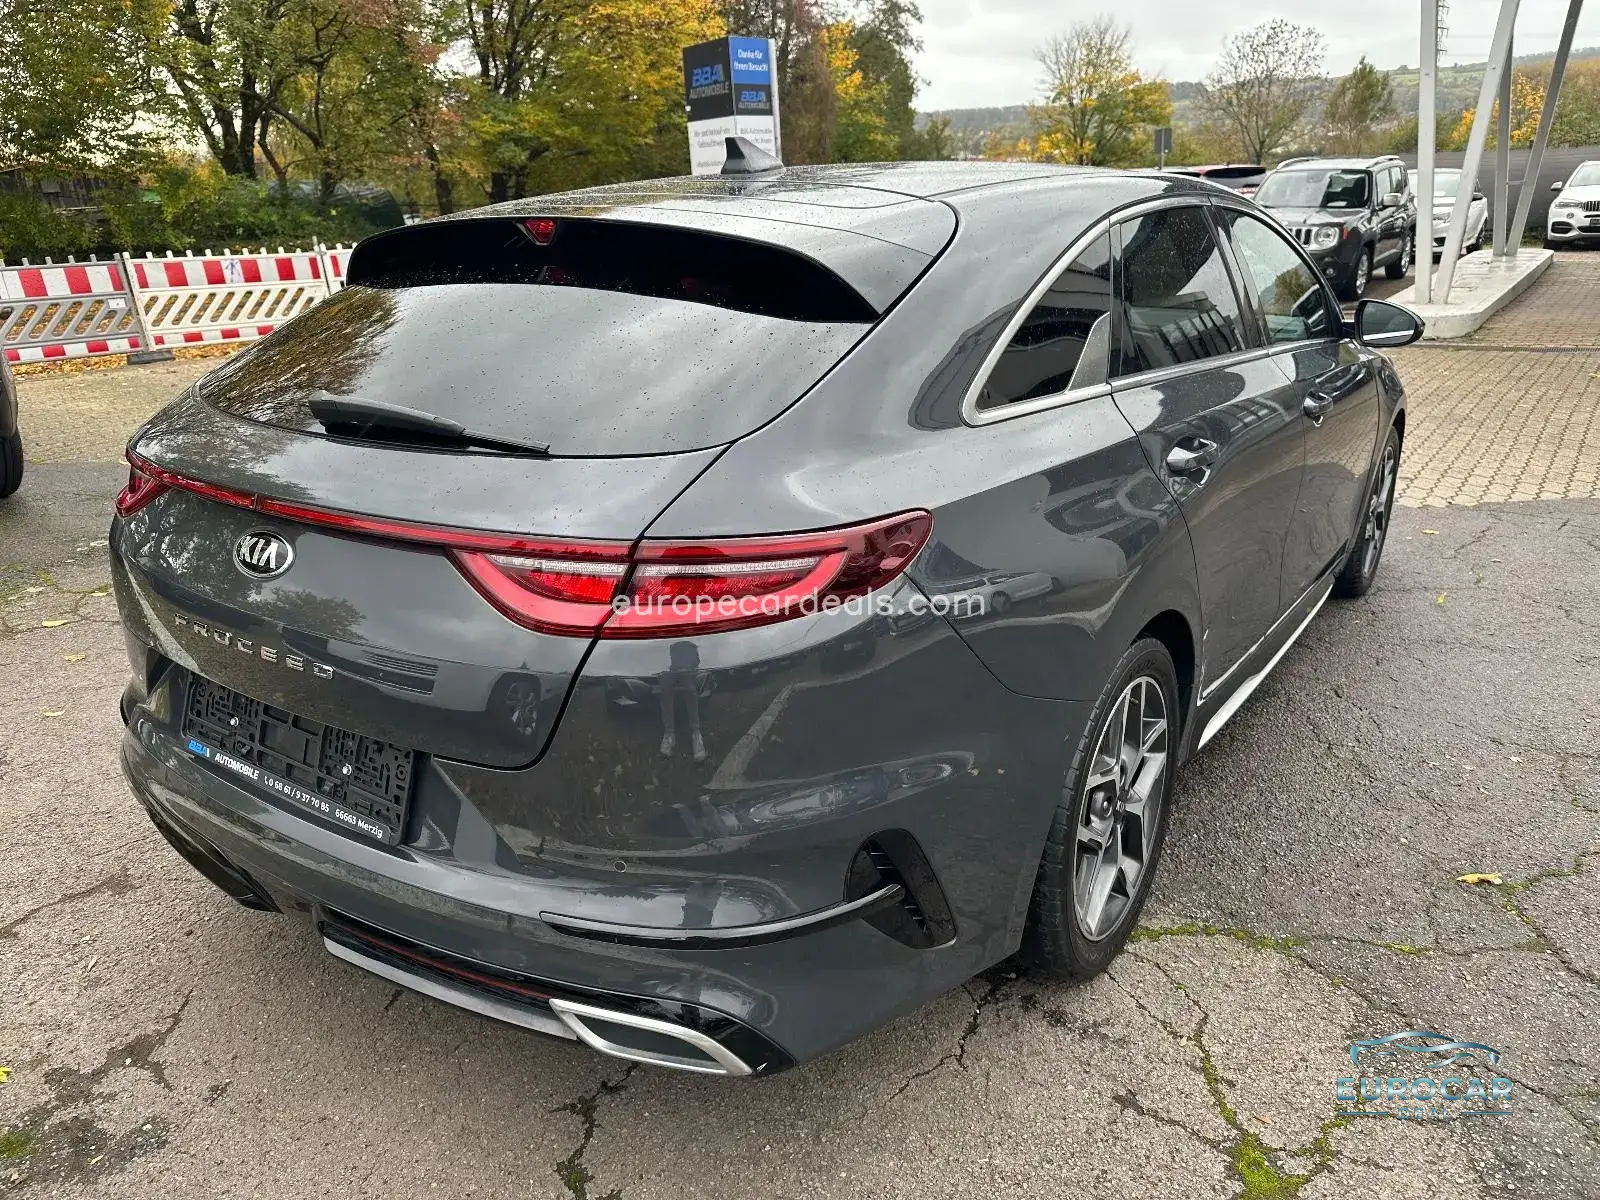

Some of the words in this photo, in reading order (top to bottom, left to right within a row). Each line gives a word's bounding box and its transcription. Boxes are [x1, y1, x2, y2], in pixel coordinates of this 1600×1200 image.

[689, 82, 729, 99] AUTOMOBILE
[239, 535, 279, 570] KIA
[174, 612, 335, 681] PROCEED
[214, 752, 260, 780] AUTOMOBILE
[295, 790, 301, 799] 9
[301, 792, 311, 803] 37
[311, 796, 320, 808] 70
[335, 808, 357, 825] 66663
[357, 818, 384, 839] Merzig
